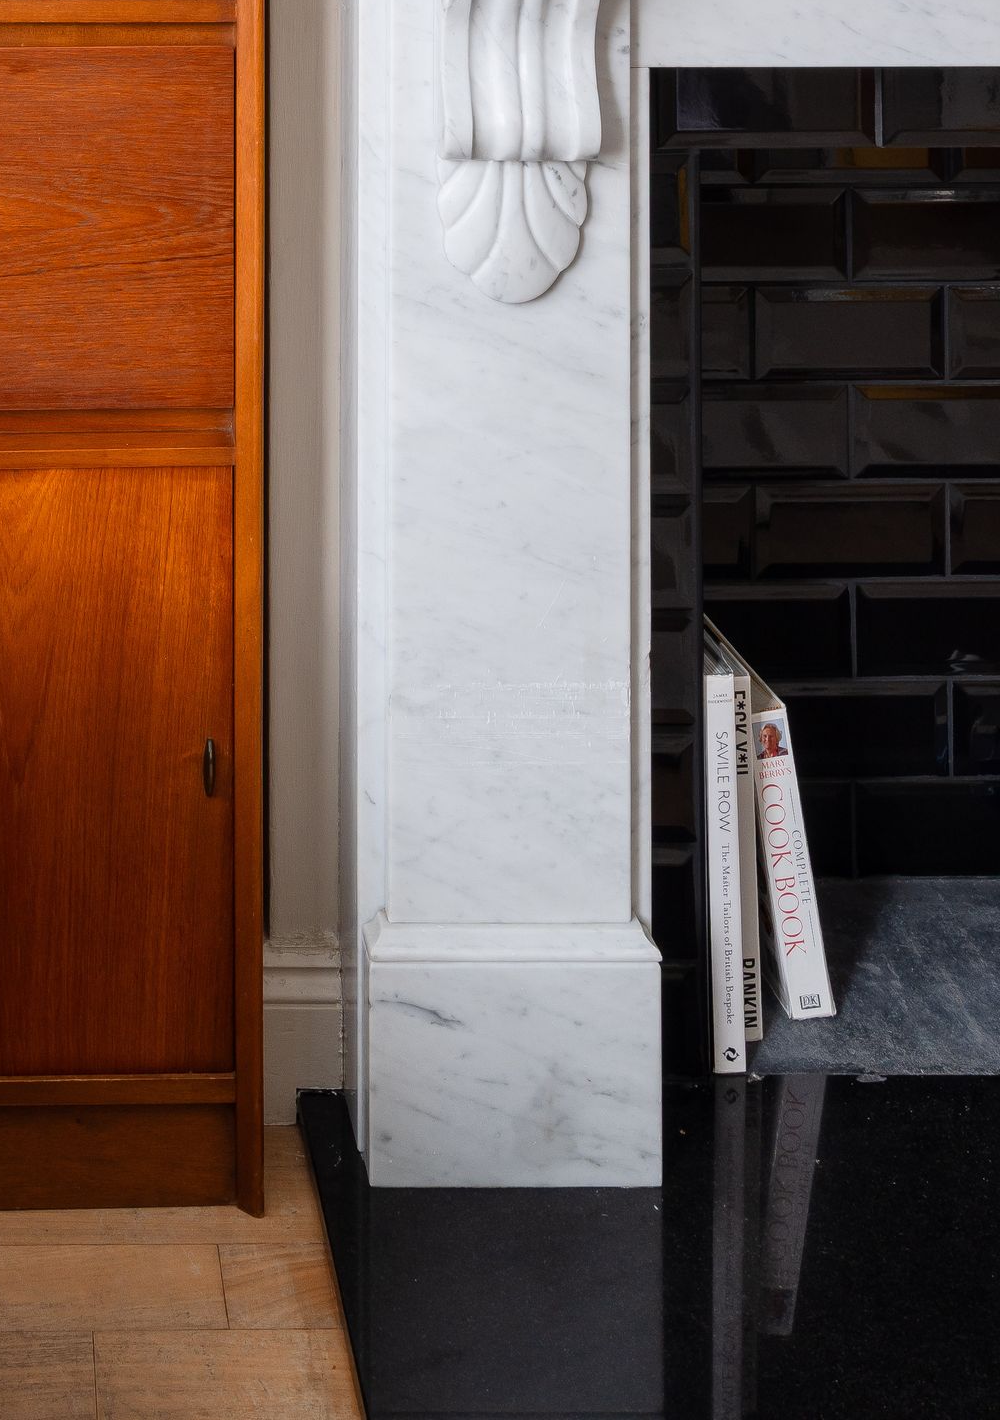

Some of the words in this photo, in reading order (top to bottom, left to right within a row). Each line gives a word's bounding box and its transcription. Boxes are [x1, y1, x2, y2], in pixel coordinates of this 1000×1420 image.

[715, 731, 730, 784] SAVILE
[758, 766, 792, 780] BERRY'S
[761, 758, 786, 770] MARY
[717, 790, 731, 833] ROW
[761, 784, 793, 868] COOK
[721, 842, 730, 863] The
[791, 829, 812, 905] COMPLETE
[721, 863, 731, 898] Master
[723, 899, 732, 935] Tailors
[774, 876, 807, 957] BOOK
[724, 934, 732, 946] of
[723, 949, 733, 983] British
[723, 985, 734, 1025] Bespoke
[801, 995, 819, 1009] DK
